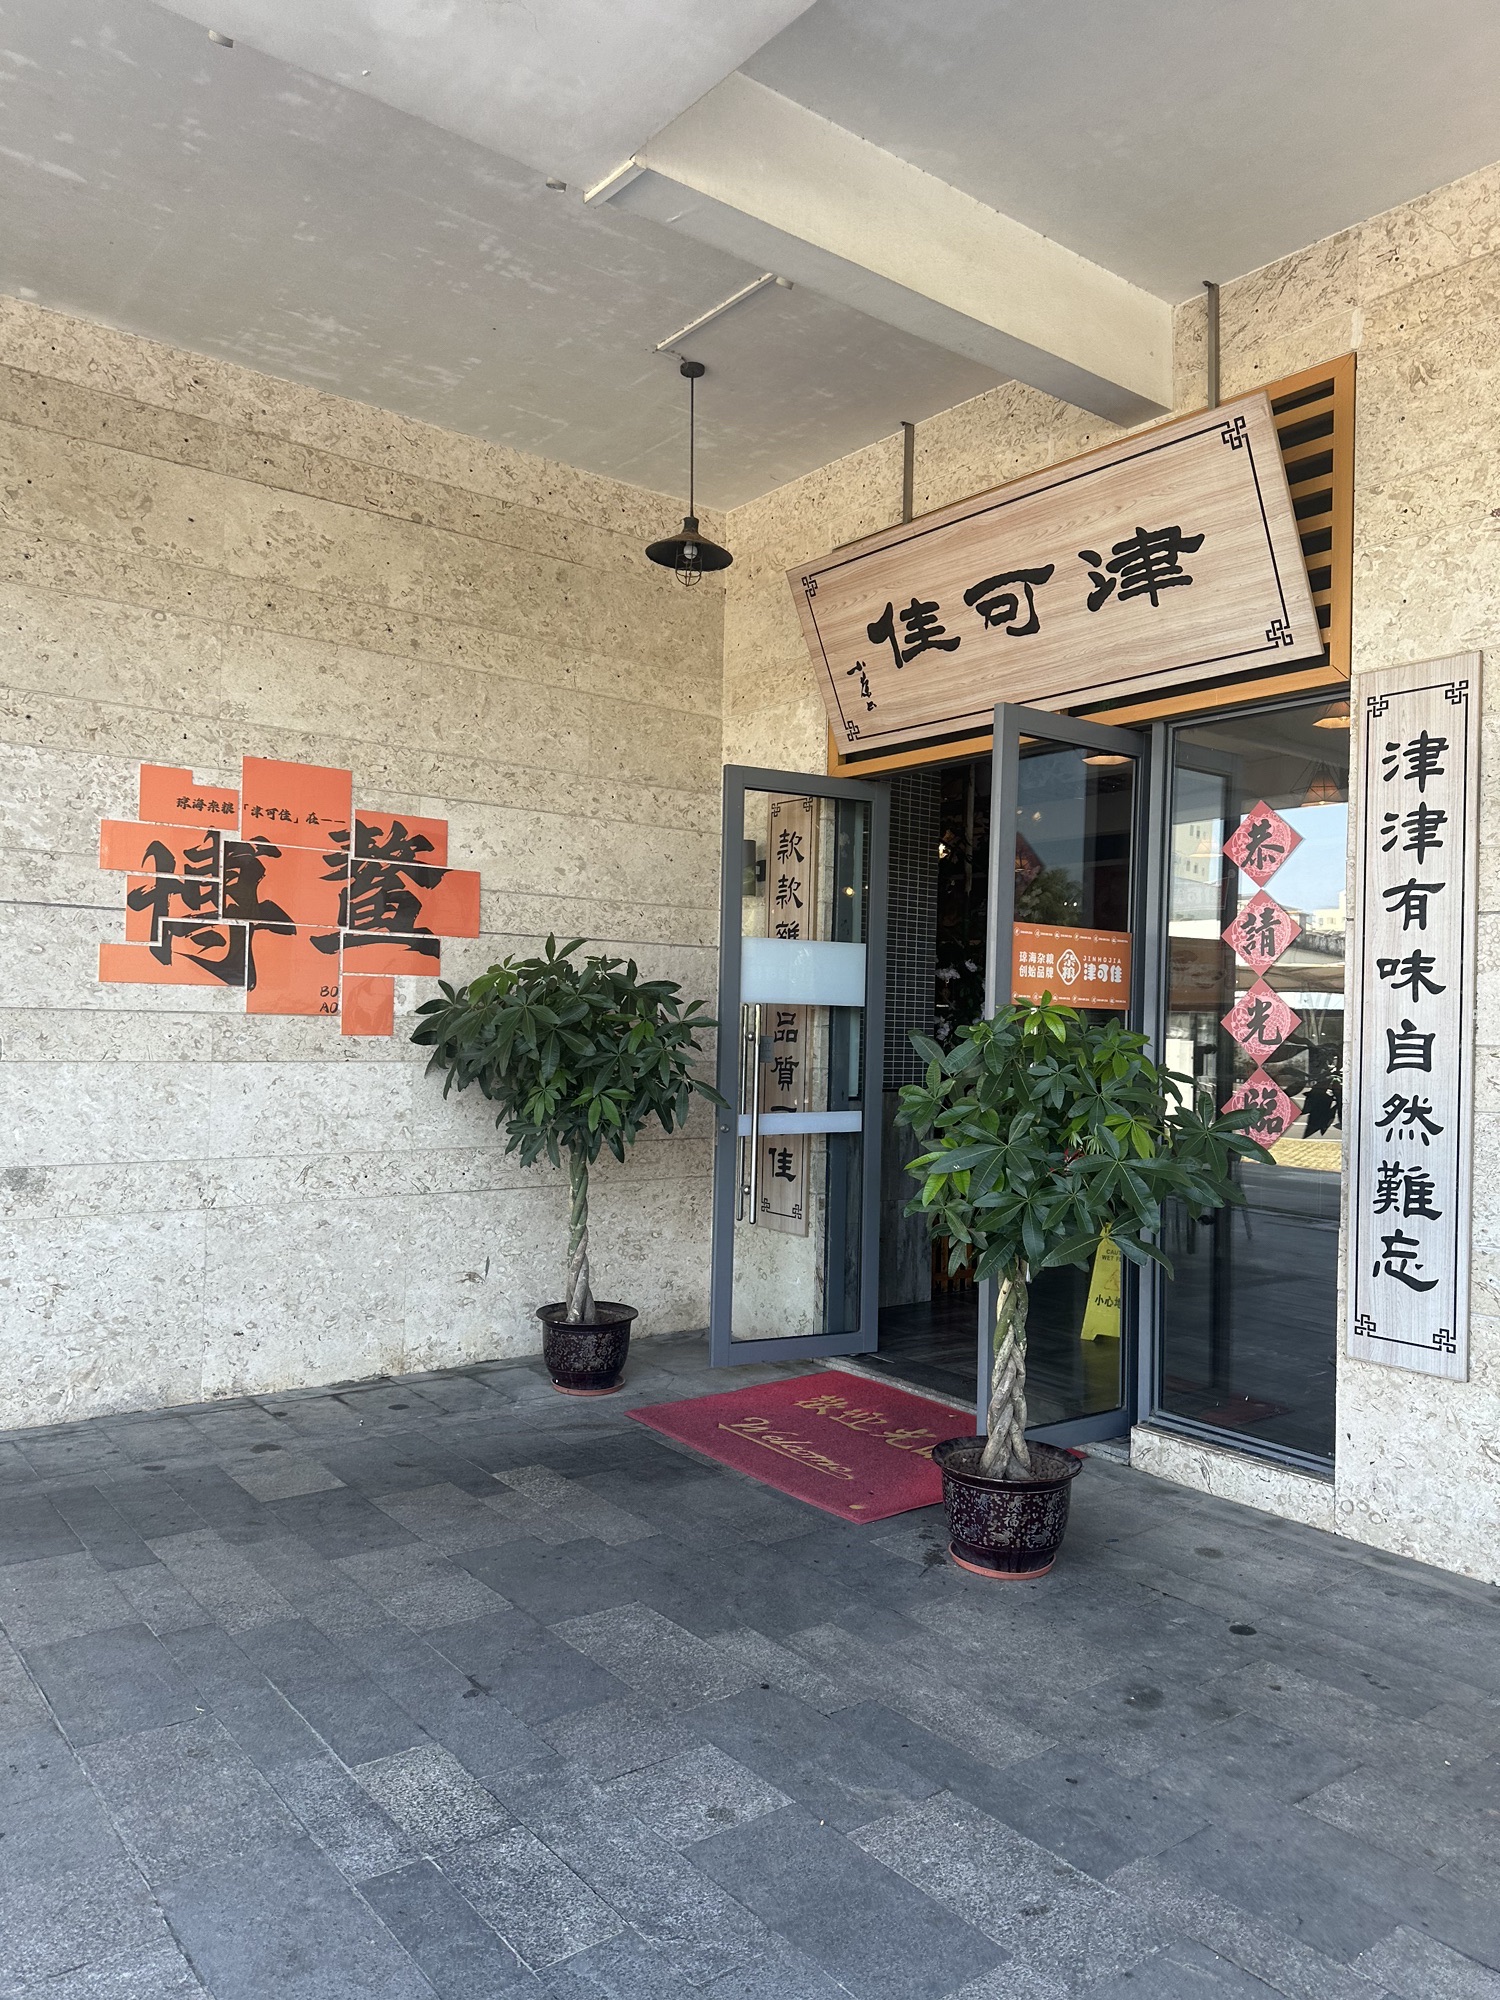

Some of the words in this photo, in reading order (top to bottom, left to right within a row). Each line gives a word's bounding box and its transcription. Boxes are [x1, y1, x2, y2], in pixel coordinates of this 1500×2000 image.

[867, 526, 1205, 668] 津可佳
[1019, 951, 1055, 965] 琼海杂粮
[1018, 964, 1055, 979] 创始品牌
[1083, 963, 1122, 983] 津可佳
[1240, 819, 1285, 1135] 恭請光臨
[320, 985, 339, 998] BO
[319, 1001, 339, 1014] AO
[1372, 730, 1449, 1292] 津津有味自然難忘
[729, 1416, 853, 1474] Welcome
[1002, 1513, 1020, 1527] 福
